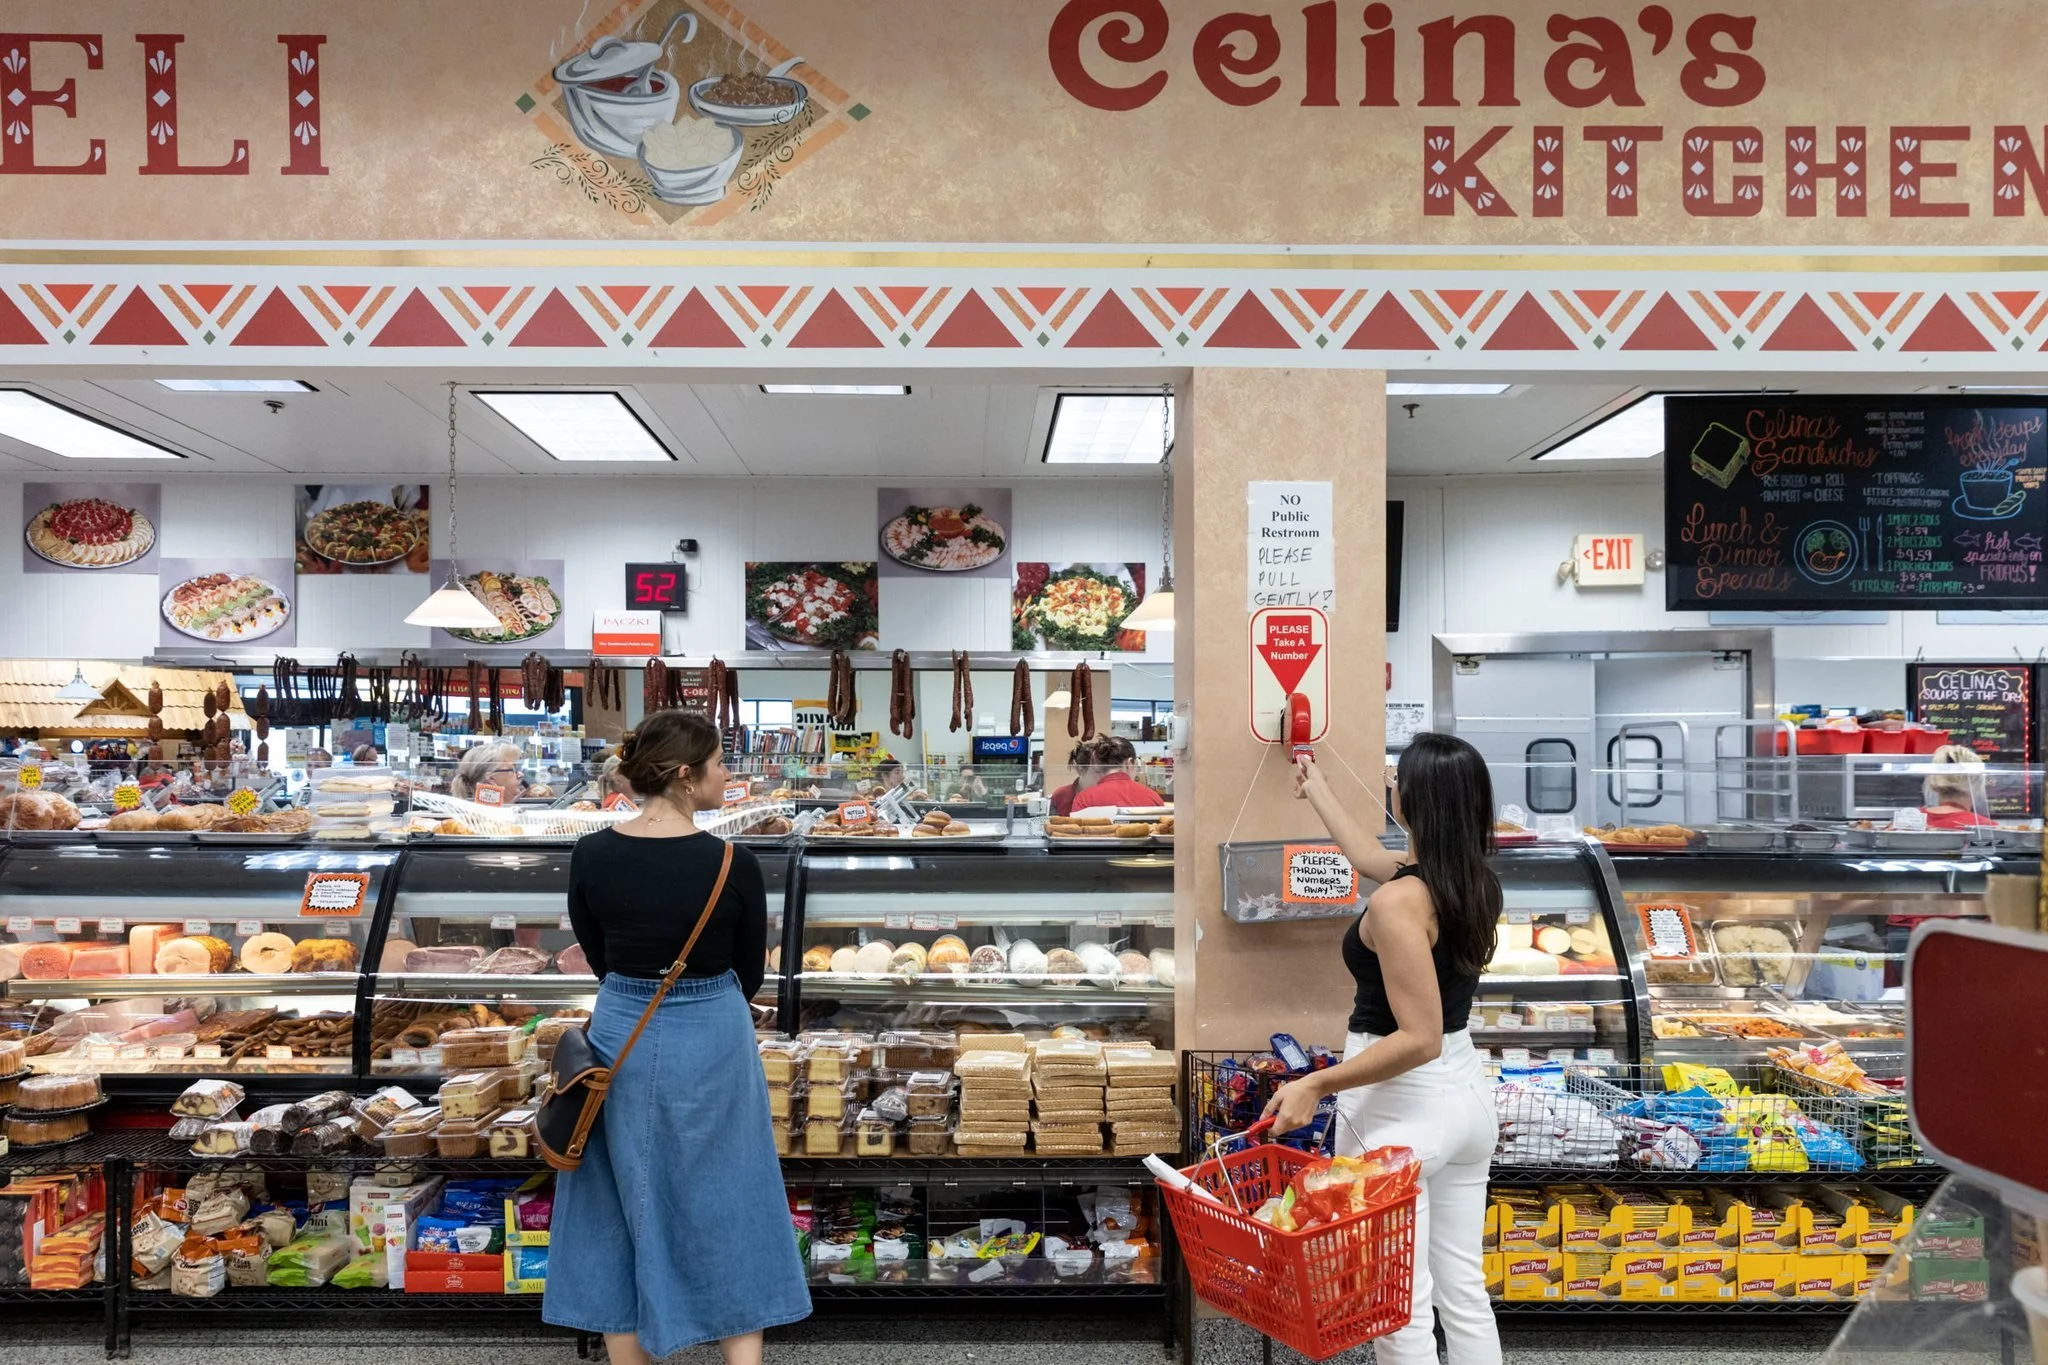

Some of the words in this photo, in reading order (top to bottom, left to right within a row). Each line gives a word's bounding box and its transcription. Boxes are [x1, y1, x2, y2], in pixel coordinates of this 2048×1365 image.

[1047, 0, 1767, 111] Celina's
[1424, 125, 2048, 218] KITCHEN
[1746, 408, 1841, 440] Celina's
[1752, 438, 1879, 476] Sandwiches
[1280, 495, 1301, 506] NO
[1272, 511, 1310, 523] Public
[1681, 502, 1755, 544] Lunch
[1760, 512, 1789, 544] &
[1262, 527, 1320, 539] Restroom
[1258, 547, 1313, 565] PLEASE
[1592, 538, 1633, 570] EXIT
[1697, 542, 1784, 567] Dinner
[1258, 571, 1300, 586] PULL
[1696, 566, 1797, 598] Specials
[635, 573, 677, 602] 52
[1269, 625, 1310, 634] PLEASE
[1273, 638, 1295, 647] Take
[1297, 638, 1306, 647] A
[1271, 651, 1308, 661] Number
[1939, 674, 2010, 691] CELINA'S
[1922, 689, 1959, 700] SOUPS
[1962, 690, 1975, 700] OF
[1976, 690, 1999, 701] THE
[1301, 855, 1340, 866] PLEASE
[1290, 866, 1326, 875] THROW
[1330, 868, 1349, 876] THE
[1297, 876, 1341, 885] NUMBERS
[132, 1221, 150, 1232] AGEL
